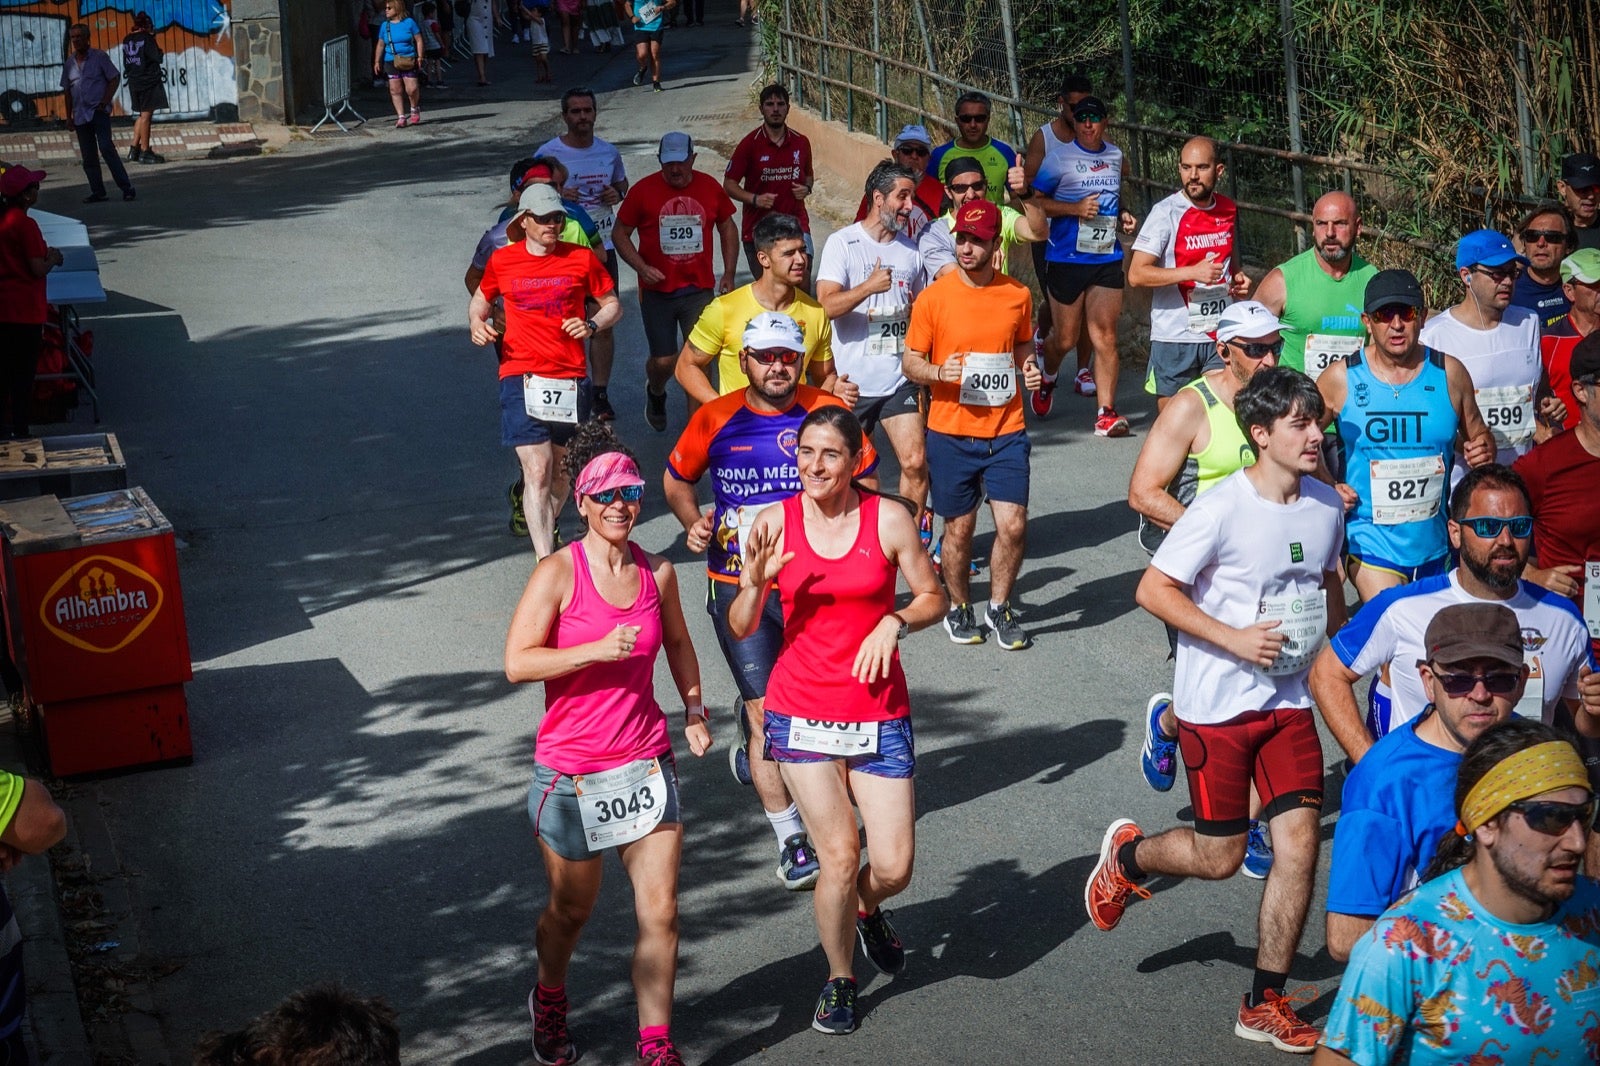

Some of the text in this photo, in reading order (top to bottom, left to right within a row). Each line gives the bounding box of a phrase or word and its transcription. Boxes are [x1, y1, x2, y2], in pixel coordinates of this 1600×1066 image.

[760, 173, 792, 182] Chartered
[763, 166, 793, 175] Standard
[670, 226, 693, 240] 529
[1092, 228, 1108, 240] 27
[1200, 299, 1227, 316] 620
[881, 321, 907, 338] 209
[1321, 315, 1359, 330] PUMA
[971, 373, 1009, 390] 3090
[542, 390, 562, 405] 37
[1487, 405, 1523, 426] 599
[1365, 411, 1428, 443] GIIT
[1388, 477, 1430, 501] 827
[55, 588, 149, 625] Alhambra
[594, 785, 655, 823] 3043
